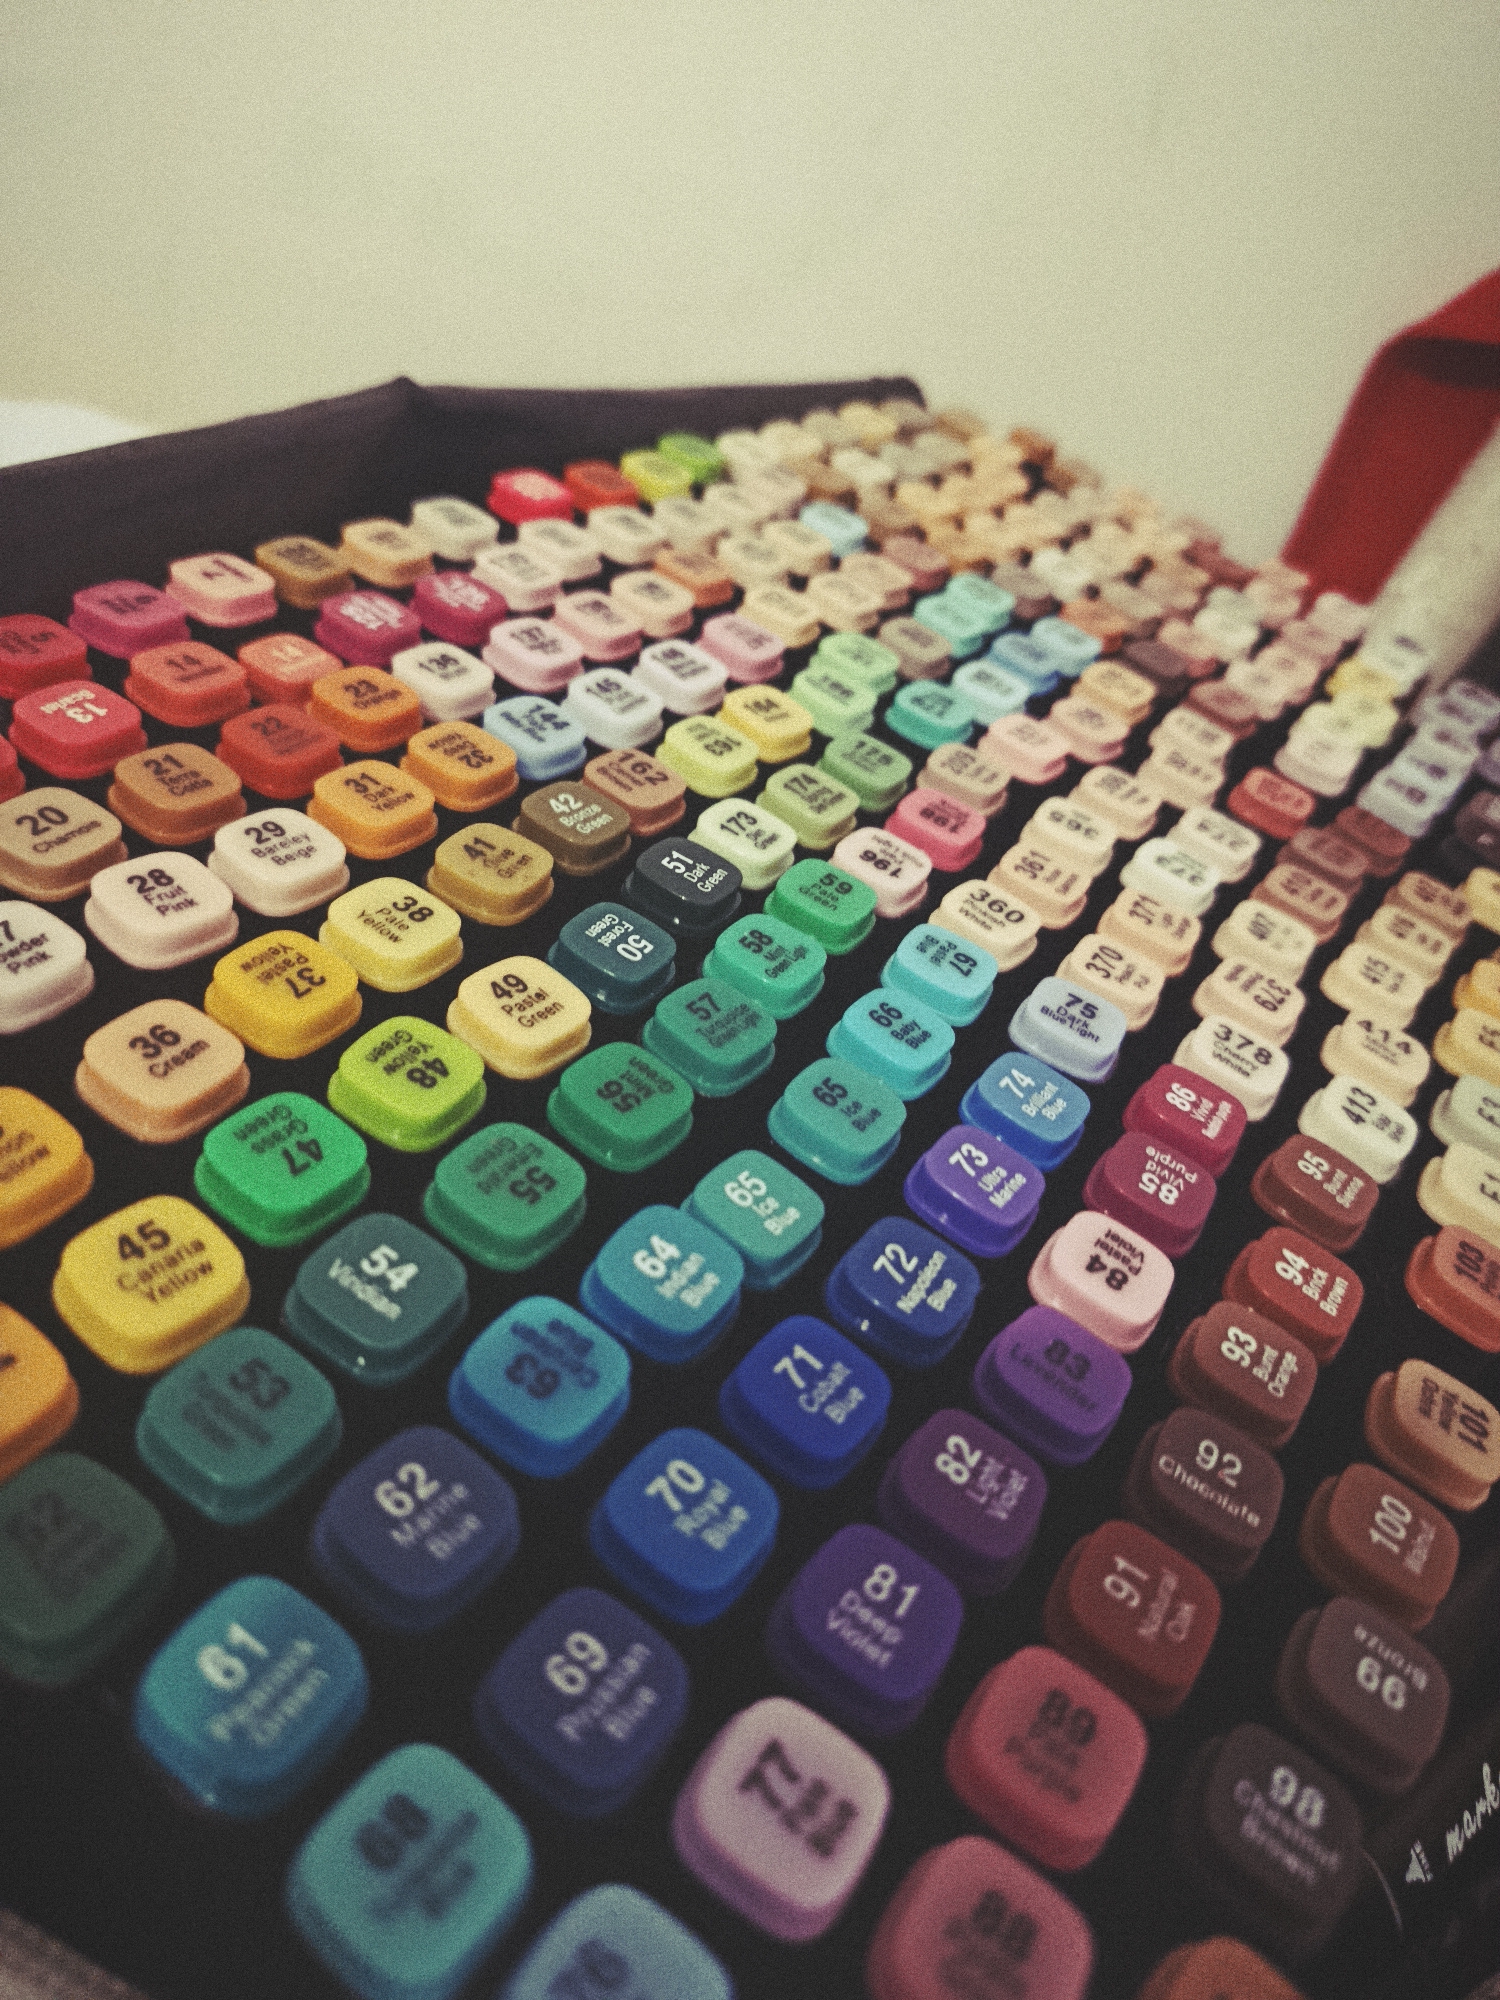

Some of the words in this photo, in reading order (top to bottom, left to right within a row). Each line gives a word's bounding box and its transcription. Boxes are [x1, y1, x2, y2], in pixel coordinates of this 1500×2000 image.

[64, 702, 108, 724] 13
[144, 754, 184, 776] 21
[619, 752, 668, 786] 162
[344, 773, 380, 793] 31
[372, 792, 414, 812] Yellow
[550, 793, 583, 813] 42
[16, 806, 68, 836] 20
[33, 819, 101, 854] Chamois
[245, 820, 287, 845] 29
[576, 814, 613, 833] Green
[720, 811, 758, 836] 173
[272, 843, 317, 866] Beige
[463, 837, 497, 860] 41
[661, 850, 694, 875] 51
[859, 850, 901, 878] 196
[127, 868, 174, 894] 28
[683, 862, 711, 883] Dark
[697, 868, 728, 893] Green
[819, 873, 853, 895] 59
[143, 887, 188, 906] Fruit
[155, 898, 198, 916] Pink
[799, 886, 837, 911] Green
[809, 883, 839, 903] Pale
[969, 888, 1025, 924] 360
[375, 906, 410, 932] Pale
[392, 896, 434, 923] 38
[958, 905, 993, 931] White
[357, 908, 402, 944] Yellow
[585, 913, 620, 938] Green
[597, 921, 634, 947] Forest
[616, 934, 654, 962] 50
[739, 929, 774, 954] 58
[6, 951, 53, 974] Pink
[240, 941, 294, 974] Yellow
[256, 951, 309, 985] Pastel
[950, 951, 978, 977] 67
[1085, 945, 1124, 979] 370
[285, 966, 326, 999] 37
[490, 973, 528, 1001] 49
[1253, 978, 1292, 1012] 379
[501, 986, 551, 1017] Pastel
[518, 1000, 565, 1028] Green
[686, 992, 721, 1020] 57
[868, 1001, 903, 1028] 66
[1040, 1005, 1068, 1027] Blue
[1056, 1004, 1092, 1030] Dark
[1064, 992, 1099, 1020] 75
[129, 1024, 181, 1059] 36
[365, 1028, 413, 1064] Green
[891, 1020, 920, 1042] Baby
[905, 1028, 933, 1050] Blue
[1213, 1023, 1273, 1066] 378
[406, 1057, 450, 1089] 48
[1211, 1049, 1252, 1078] White
[596, 1079, 642, 1114] 56
[813, 1077, 848, 1108] 65
[999, 1068, 1036, 1098] 74
[1165, 1083, 1196, 1111] 86
[840, 1101, 863, 1118] Ice
[852, 1107, 882, 1133] Blue
[1041, 1097, 1068, 1121] Blue
[1341, 1086, 1377, 1125] 413
[233, 1104, 293, 1141] Green
[281, 1138, 324, 1177] 47
[948, 1143, 989, 1177] 73
[1145, 1145, 1199, 1184] Purple
[1298, 1150, 1330, 1181] 95
[509, 1166, 557, 1205] 55
[724, 1170, 767, 1207] 65
[1138, 1172, 1179, 1206] 85
[1144, 1160, 1185, 1191] Vivid
[764, 1206, 800, 1236] Blue
[117, 1219, 171, 1262] 45
[1103, 1227, 1145, 1262] Violet
[360, 1243, 419, 1293] 54
[632, 1235, 681, 1279] 64
[872, 1242, 919, 1284] 72
[1085, 1253, 1129, 1291] 84
[1094, 1237, 1142, 1277] Pastel
[1275, 1248, 1309, 1286] 94
[1454, 1240, 1485, 1282] 103
[144, 1259, 214, 1305] Yellow
[925, 1278, 958, 1312] Blue
[1302, 1267, 1328, 1300] Brick
[1320, 1276, 1349, 1317] Brown
[1221, 1326, 1257, 1367] 93
[773, 1344, 824, 1389] 71
[824, 1387, 867, 1426] Blue
[1457, 1401, 1490, 1454] 101
[934, 1434, 982, 1485] 82
[1196, 1439, 1242, 1488] 92
[375, 1462, 441, 1519] 62
[645, 1458, 705, 1513] 70
[1159, 1454, 1260, 1528] Chocolate
[1370, 1494, 1412, 1554] 100
[863, 1564, 922, 1617] 81
[1104, 1555, 1149, 1608] 91
[197, 1622, 269, 1691] 61
[544, 1631, 608, 1696] 69
[1445, 1762, 1500, 1863] mark
